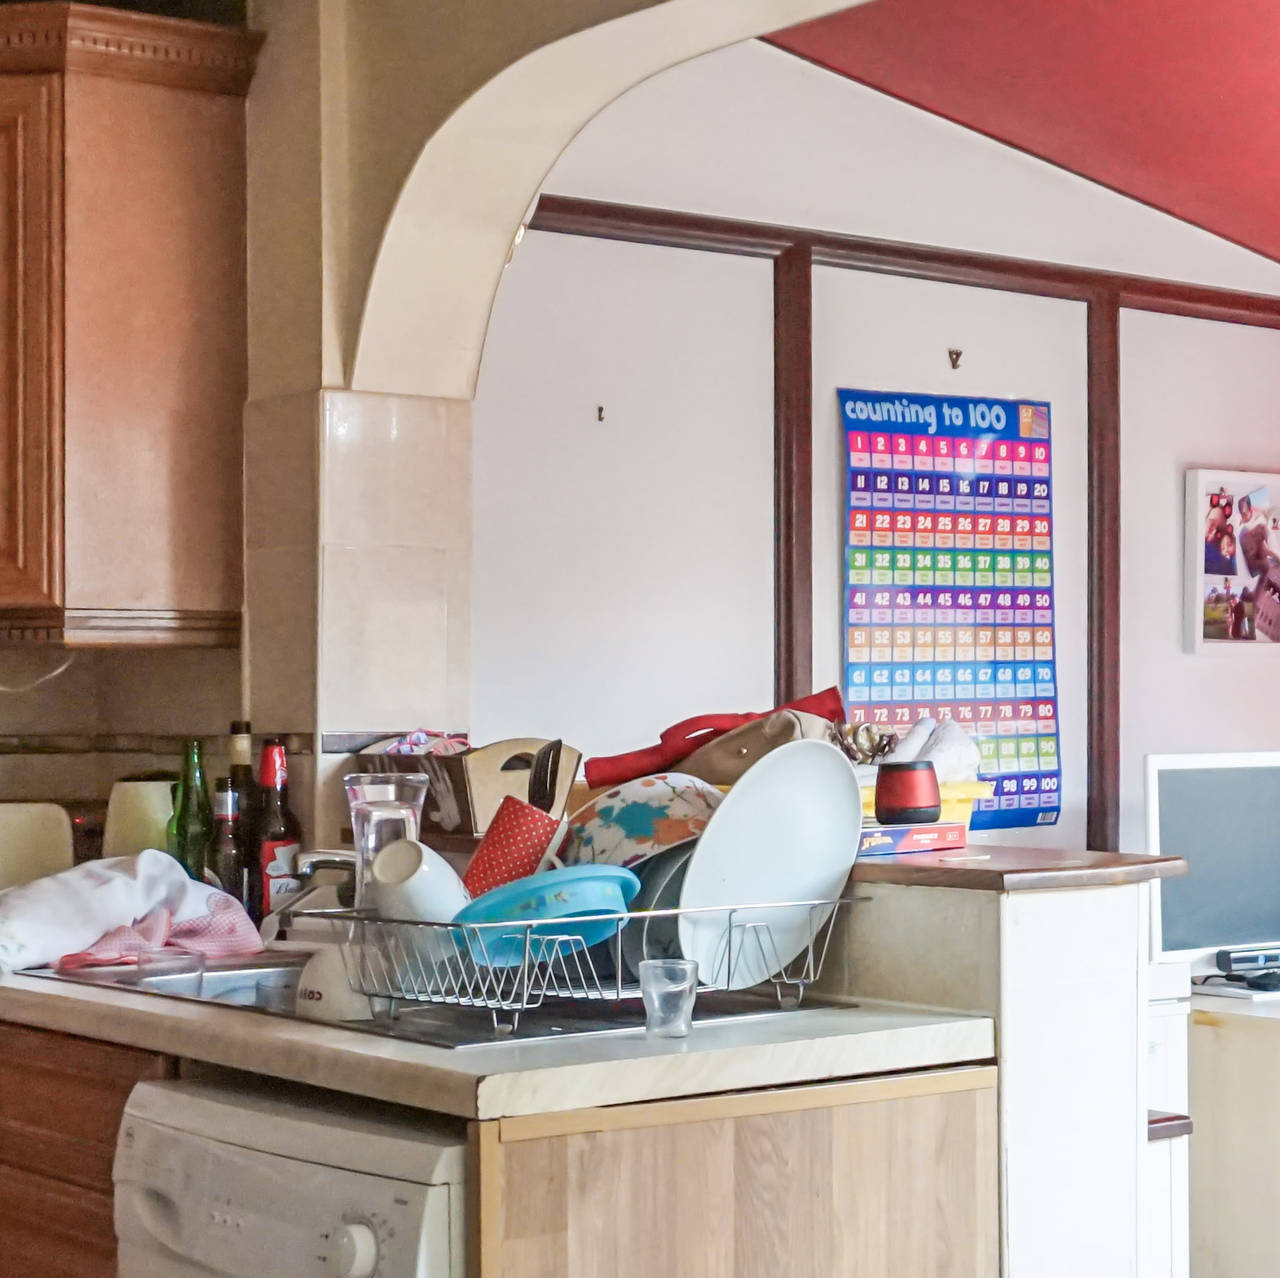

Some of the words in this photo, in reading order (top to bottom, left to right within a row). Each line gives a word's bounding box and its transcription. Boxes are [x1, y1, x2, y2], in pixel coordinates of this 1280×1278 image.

[845, 398, 937, 434] counting
[942, 402, 964, 426] to
[968, 403, 1007, 430] 100
[876, 436, 885, 451] 2
[898, 438, 906, 452] 3
[918, 439, 927, 453] 4
[939, 440, 948, 455] 5
[959, 442, 968, 457] 6
[980, 443, 988, 457] 7
[999, 444, 1007, 458] 8
[1017, 445, 1026, 458] 9
[1034, 447, 1046, 460] 10
[857, 475, 865, 489] 11
[876, 475, 888, 490] 12
[897, 476, 909, 491] 13
[918, 478, 930, 491] 14
[939, 478, 951, 493] 15
[959, 479, 971, 494] 16
[979, 481, 990, 494] 17
[998, 481, 1009, 495] 18
[1016, 482, 1028, 496] 19
[1033, 483, 1048, 497] 20
[854, 513, 867, 528] 21
[875, 514, 891, 528] 22
[896, 515, 912, 529] 23
[917, 515, 932, 530] 24
[937, 516, 952, 531] 25
[957, 517, 972, 531] 26
[977, 518, 991, 532] 27
[997, 518, 1011, 532] 28
[1015, 519, 1030, 533] 29
[1034, 520, 1049, 534] 30
[854, 552, 867, 567] 31
[874, 553, 890, 567] 32
[896, 553, 911, 568] 33
[916, 554, 932, 568] 34
[937, 554, 952, 569] 35
[957, 555, 972, 569] 36
[977, 555, 991, 569] 37
[1034, 557, 1050, 570] 40
[853, 592, 866, 606] 41
[874, 592, 890, 606] 42
[895, 592, 911, 606] 43
[916, 592, 933, 606] 44
[937, 592, 953, 607] 45
[957, 593, 973, 606] 46
[977, 593, 992, 606] 47
[997, 593, 1012, 607] 48
[1016, 593, 1031, 606] 49
[1035, 594, 1050, 607] 50
[853, 630, 866, 645] 51
[916, 631, 932, 644] 54
[978, 630, 992, 644] 57
[997, 631, 1012, 644] 58
[1017, 630, 1031, 644] 59
[1035, 631, 1051, 643] 60
[852, 670, 866, 684] 61
[873, 669, 889, 684] 62
[894, 669, 911, 683] 63
[915, 669, 932, 683] 64
[936, 668, 953, 683] 65
[956, 668, 973, 682] 66
[977, 668, 992, 682] 67
[997, 668, 1013, 682] 68
[1017, 667, 1032, 681] 69
[1037, 667, 1052, 681] 70
[853, 709, 865, 723] 71
[874, 708, 889, 722] 72
[895, 707, 910, 722] 73
[937, 706, 953, 720] 75
[958, 706, 973, 719] 76
[978, 705, 993, 719] 77
[999, 705, 1013, 718] 78
[1018, 704, 1033, 717] 79
[1038, 704, 1054, 717] 80
[1039, 740, 1056, 753] 90
[1002, 779, 1018, 793] 98
[1022, 778, 1038, 791] 99
[1041, 777, 1058, 791] 100
